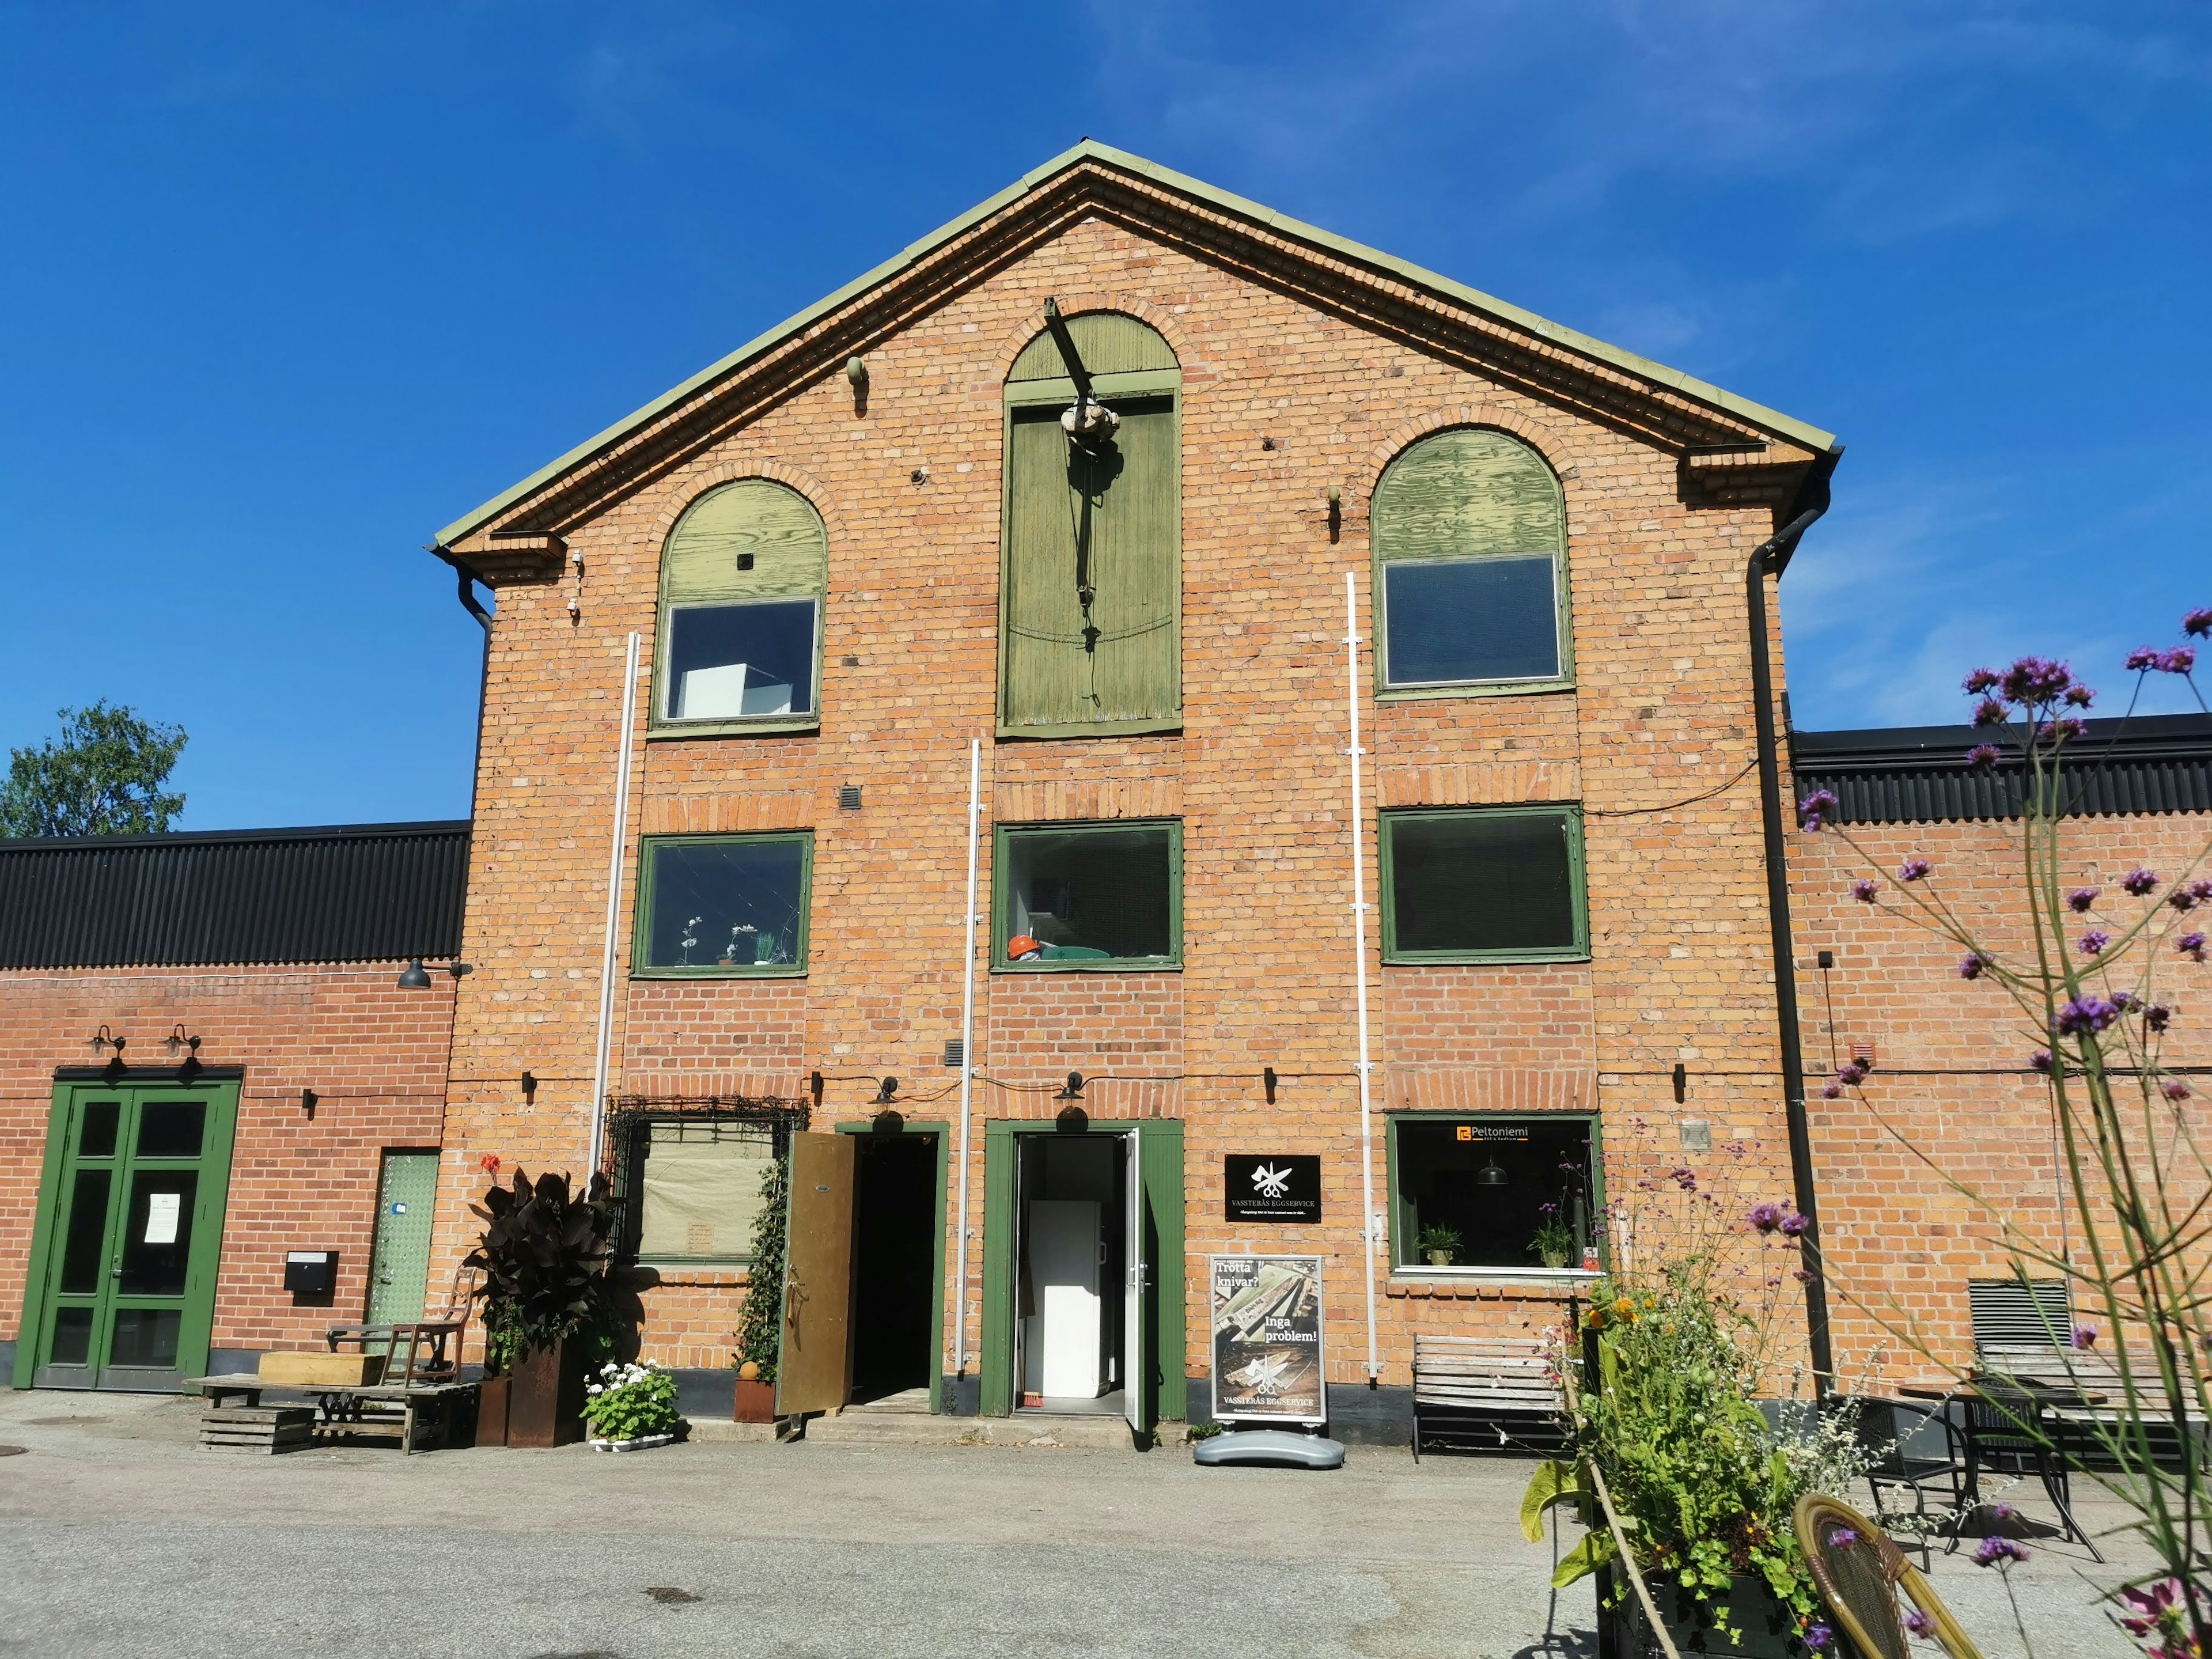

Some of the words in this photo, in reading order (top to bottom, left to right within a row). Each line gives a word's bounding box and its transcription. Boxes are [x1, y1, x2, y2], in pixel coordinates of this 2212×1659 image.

[1472, 1127, 1528, 1137] Peltoniemi
[1232, 1199, 1270, 1207] VASSTERÅS
[1217, 1262, 1251, 1272] Trötta
[1217, 1275, 1259, 1287] knivar?
[1265, 1316, 1291, 1330] Inga
[1265, 1330, 1316, 1343] problem!
[1224, 1396, 1265, 1404] VASSTERÅS
[1267, 1397, 1313, 1406] EGGSERVICE
